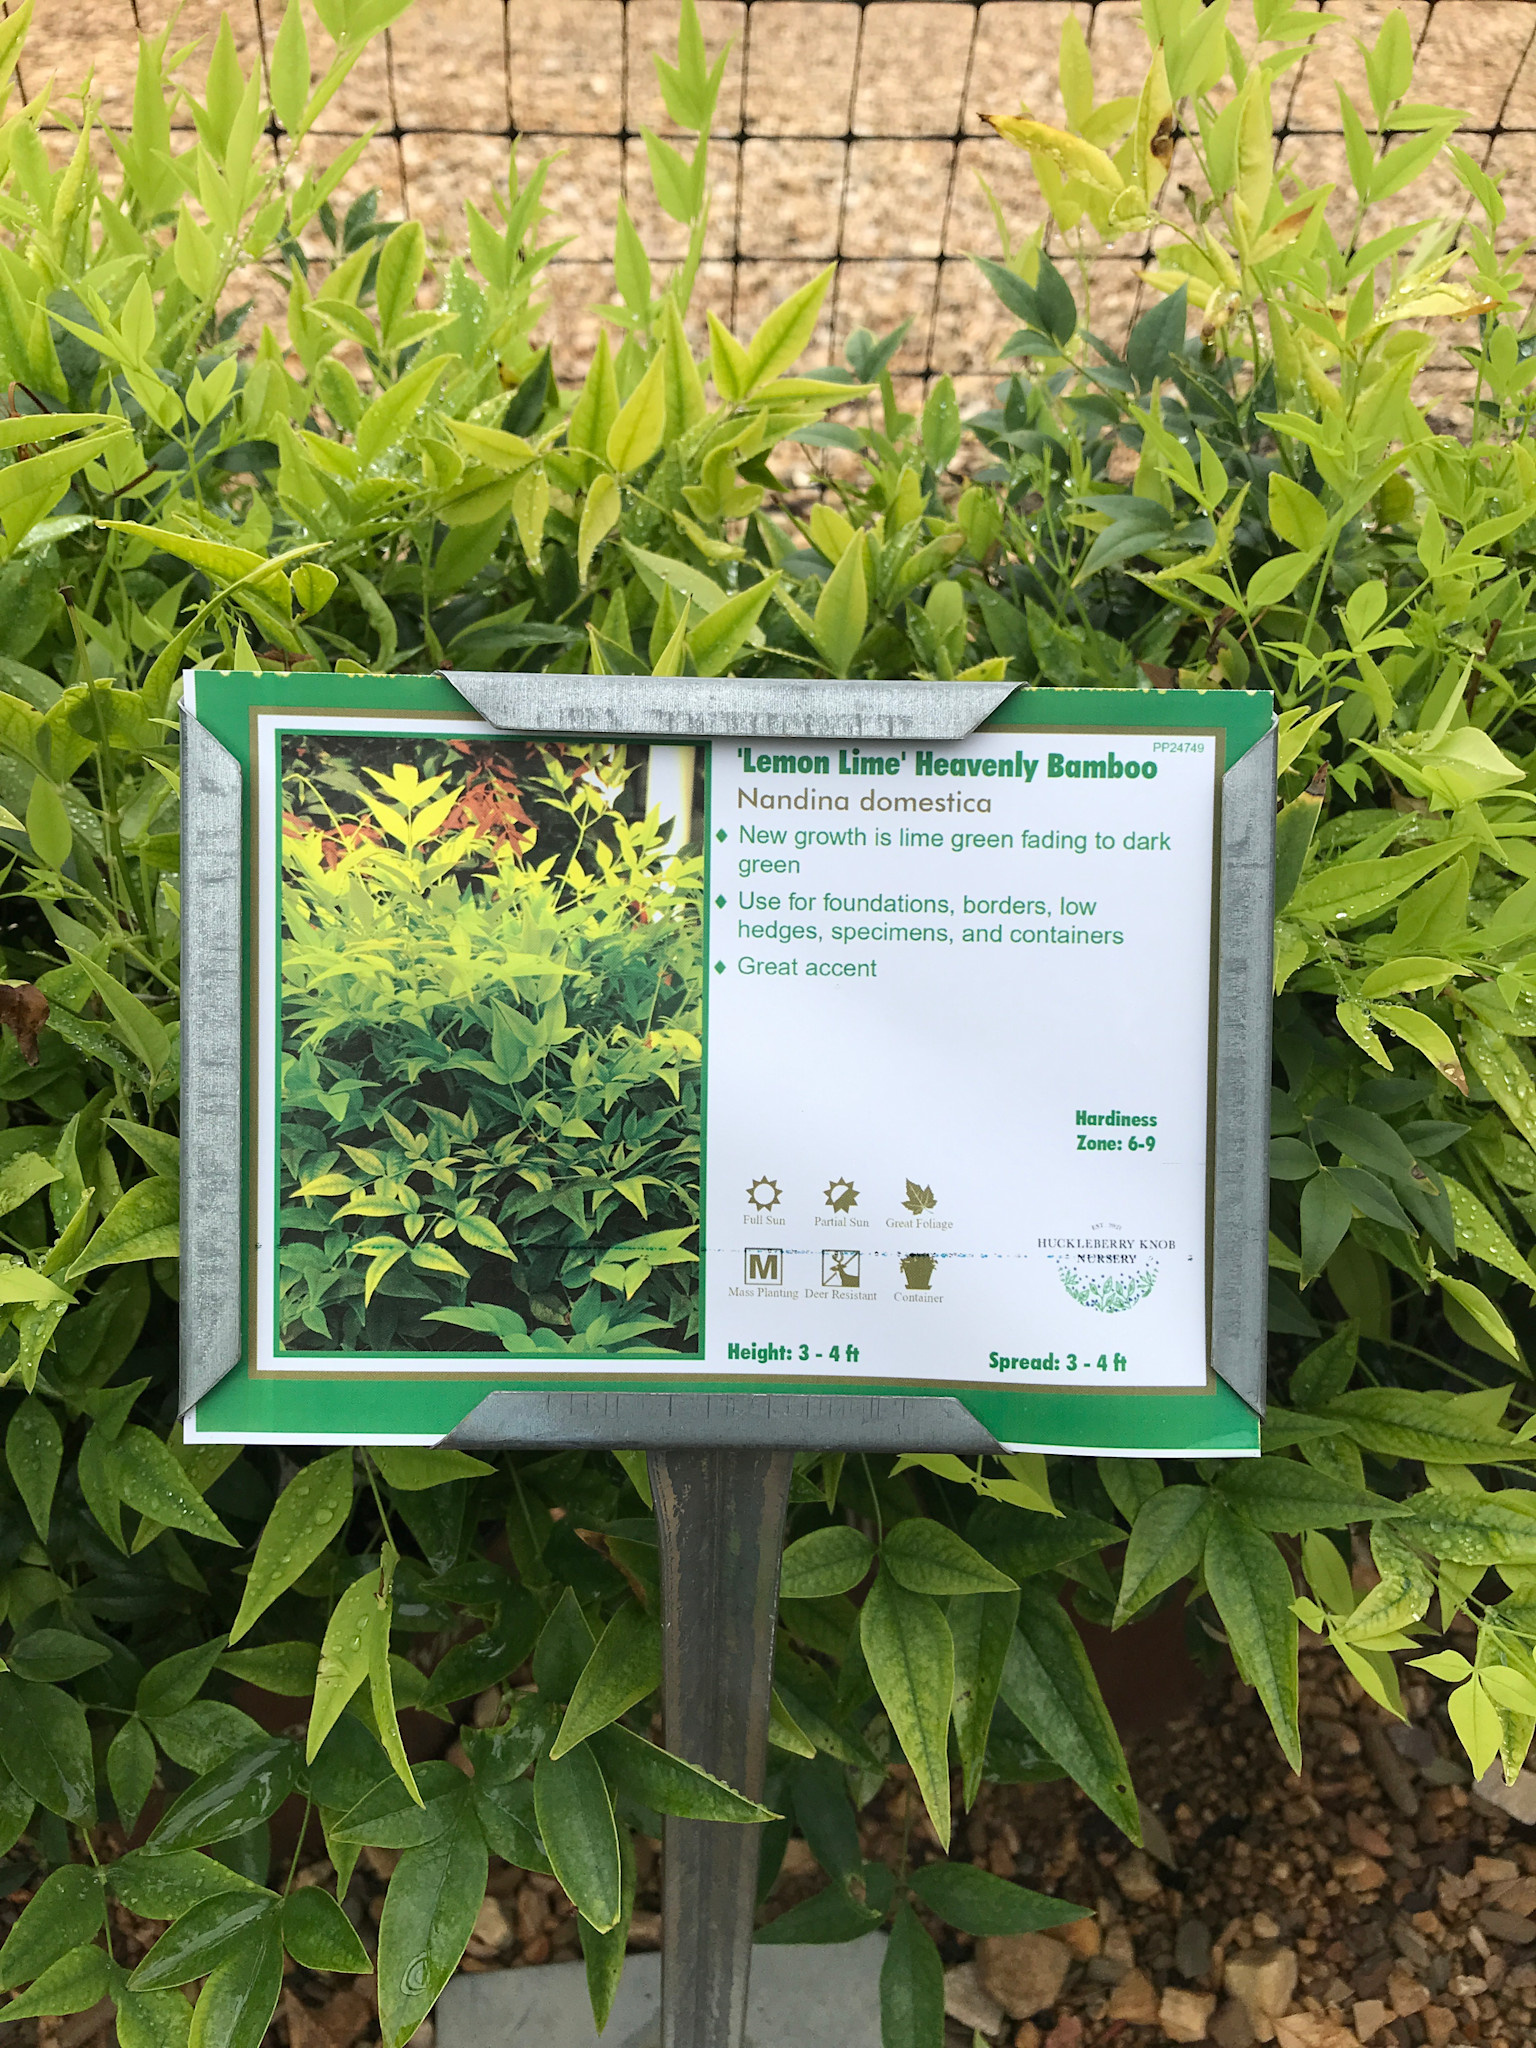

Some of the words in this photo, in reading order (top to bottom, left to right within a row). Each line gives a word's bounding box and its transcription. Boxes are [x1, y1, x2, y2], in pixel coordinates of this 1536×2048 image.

[1153, 742, 1205, 754] PP24749
[737, 748, 829, 775] 'Lemon
[839, 749, 907, 777] Lime'
[916, 752, 1038, 782] Heavenly
[1047, 752, 1158, 780] Bamboo
[738, 788, 849, 811] Nandina
[860, 789, 992, 814] domestica
[740, 825, 788, 845] New
[795, 827, 867, 850] growth
[875, 828, 892, 847] is
[900, 828, 944, 848] lime
[951, 834, 1014, 853] green
[1021, 830, 1088, 855] fading
[1095, 832, 1116, 850] to
[1123, 831, 1172, 851] dark
[739, 859, 801, 878] green
[740, 891, 782, 911] Use
[789, 892, 817, 912] for
[823, 893, 955, 917] foundations,
[964, 895, 1052, 918] borders,
[1060, 897, 1098, 916] low
[739, 920, 823, 944] hedges,
[832, 922, 954, 945] specimens,
[962, 924, 1003, 943] and
[1010, 925, 1125, 945] containers
[738, 956, 799, 976] Great
[806, 960, 878, 978] accent
[1076, 1110, 1158, 1128] Hardiness
[1077, 1135, 1123, 1152] Zone:
[1128, 1136, 1156, 1152] 6-9
[744, 1215, 763, 1225] Full
[766, 1216, 786, 1226] Sun
[815, 1217, 846, 1228] Partial
[850, 1218, 870, 1228] Sun
[886, 1218, 914, 1229] Great
[915, 1219, 954, 1230] Foliage
[1038, 1239, 1135, 1250] HUCKLEBERRY
[1140, 1240, 1176, 1250] KNOB
[1078, 1254, 1137, 1264] NURSERY
[729, 1287, 755, 1297] Mass
[757, 1287, 799, 1301] Planting
[805, 1289, 830, 1299] Deer
[832, 1290, 878, 1301] Resistant
[893, 1292, 944, 1303] Container
[728, 1342, 793, 1364] Height:
[799, 1344, 810, 1362] 3
[829, 1346, 841, 1363] 4
[846, 1344, 860, 1363] ft
[989, 1352, 1061, 1373] Spread:
[1066, 1354, 1078, 1372] 3
[1097, 1355, 1108, 1372] 4
[1113, 1353, 1128, 1372] ft
